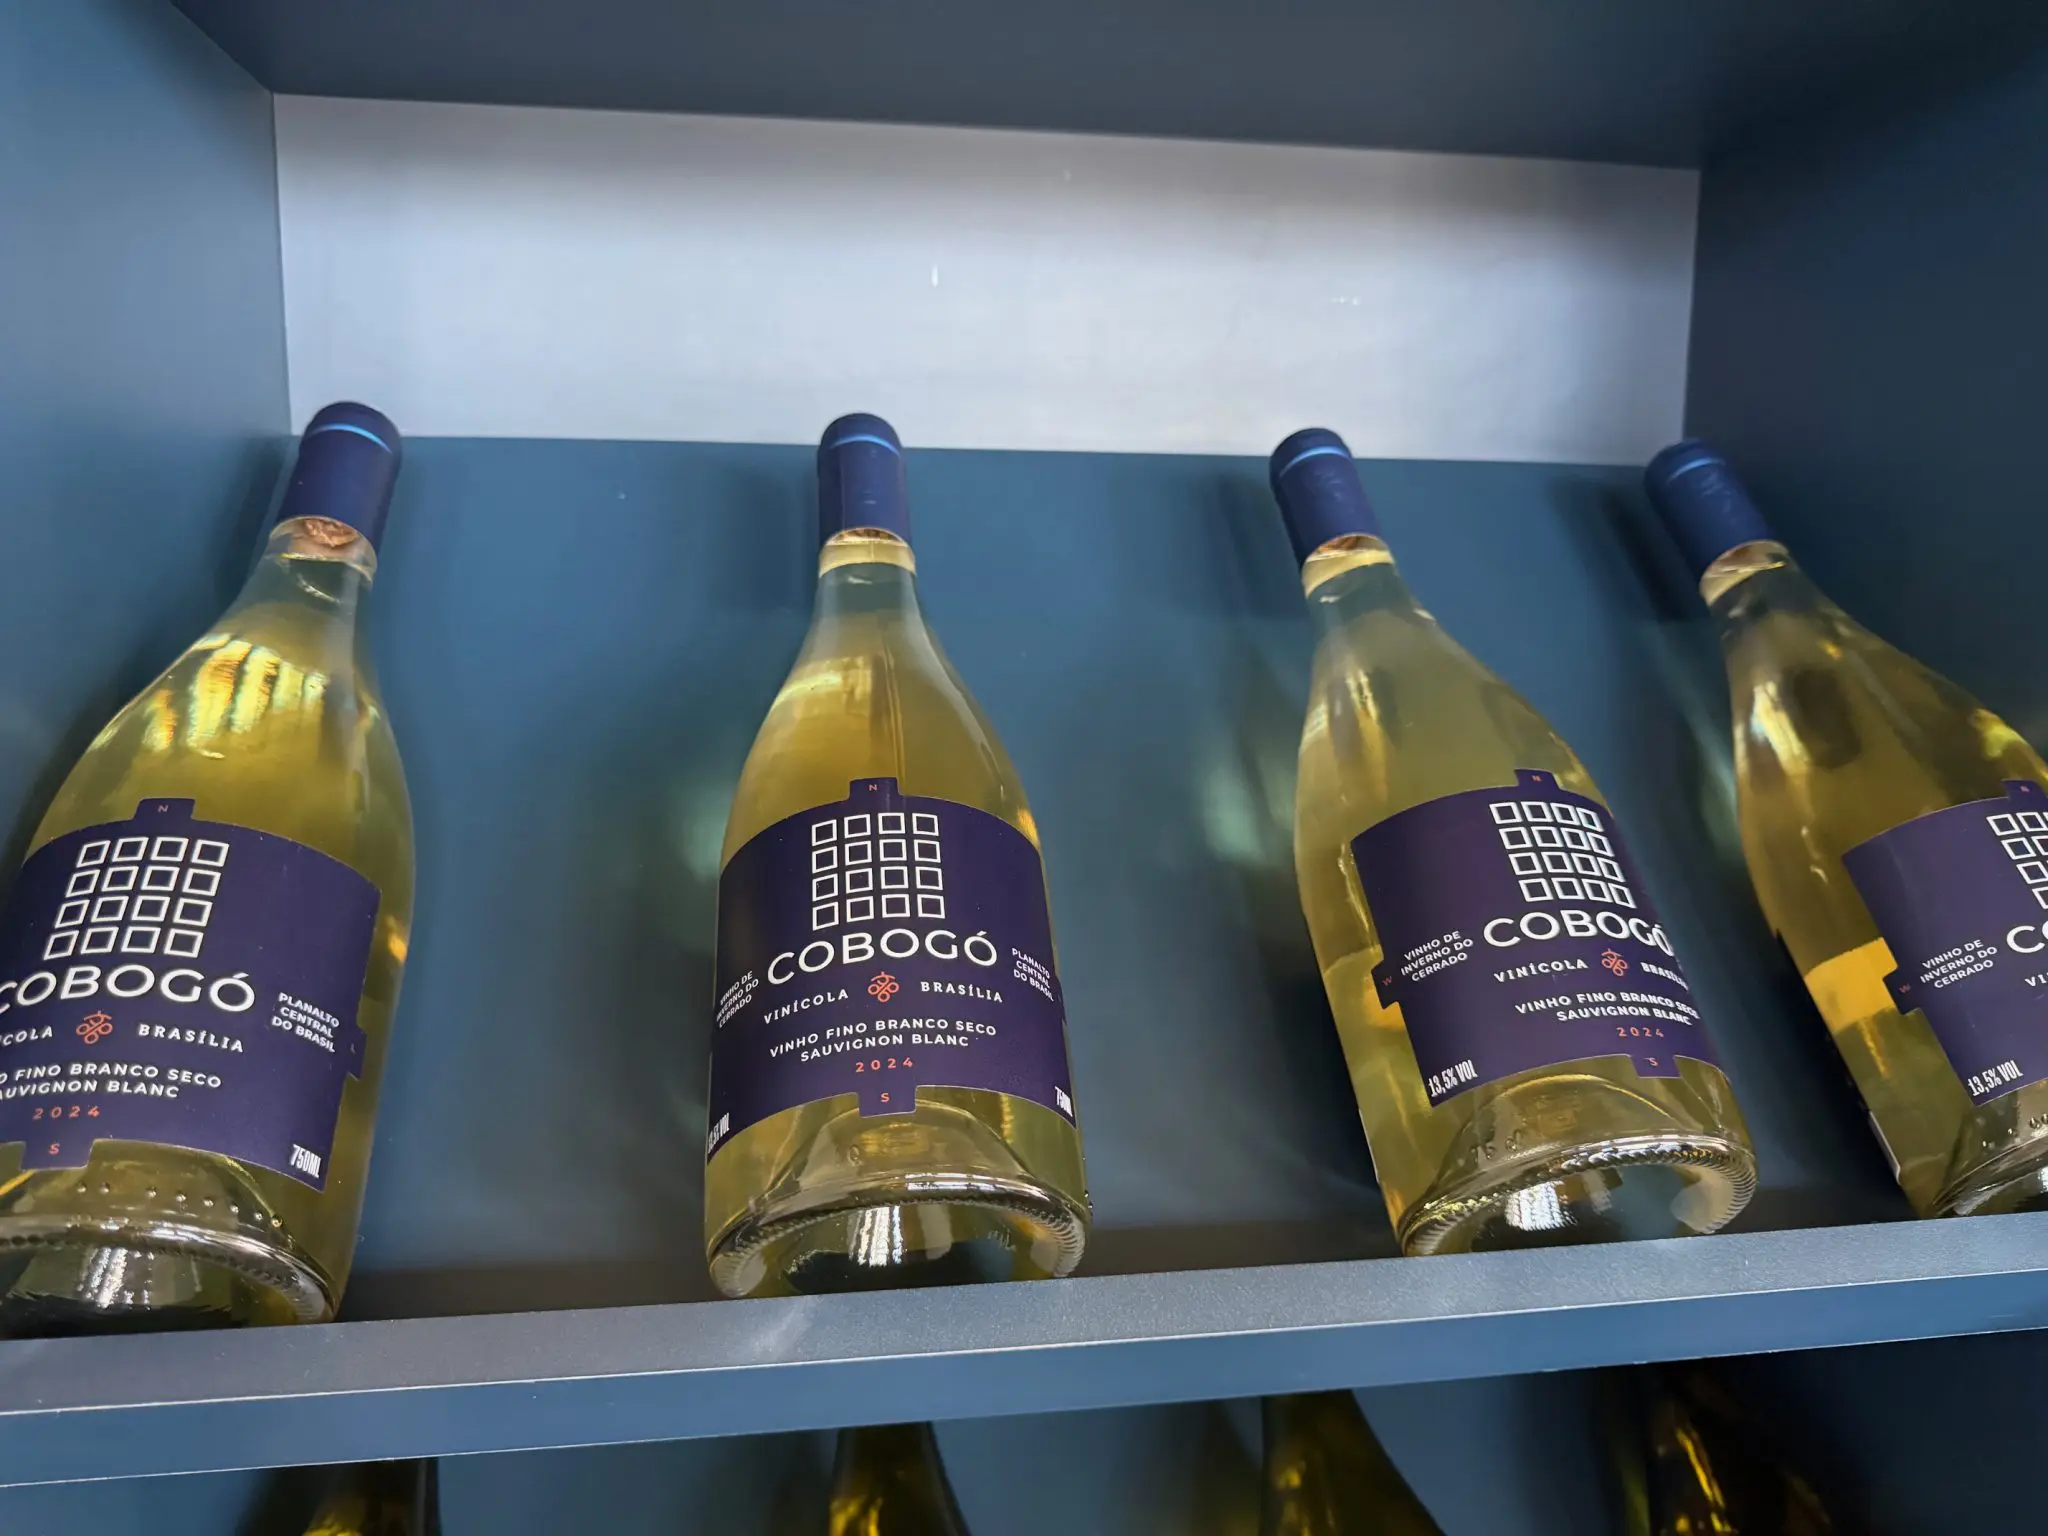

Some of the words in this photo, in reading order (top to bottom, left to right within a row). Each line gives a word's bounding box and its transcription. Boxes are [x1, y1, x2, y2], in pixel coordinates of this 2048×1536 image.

[868, 783, 878, 792] N
[157, 804, 170, 813] N
[767, 928, 998, 985] COBOGÓ
[1400, 946, 1451, 976] INVERNO
[1452, 937, 1474, 954] DO
[1403, 938, 1440, 961] VINHO
[1442, 930, 1461, 944] DE
[1923, 947, 1963, 969] VINHO
[1964, 939, 1984, 955] DE
[741, 970, 753, 985] DE
[1011, 947, 1051, 980] PLANALTO
[1013, 968, 1028, 982] DO
[1016, 960, 1050, 989] CENTRAL
[1411, 952, 1469, 983] CERRADO
[1494, 958, 1589, 984] VINÍCOLA
[1919, 957, 1974, 983] INVERNO
[1976, 946, 1998, 962] DO
[1933, 959, 1994, 989] CERRADO
[745, 978, 759, 993] DO
[278, 992, 340, 1029] PLANALTO
[763, 988, 849, 1025] VINÍCOLA
[920, 980, 1003, 1004] BRASÍLIA
[1515, 995, 1572, 1015] VINHO
[1577, 991, 1617, 1004] FINO
[1620, 991, 1675, 1008] BRANCO
[1556, 1006, 1652, 1022] SAUVIGNON
[1652, 1007, 1693, 1026] BLANC
[272, 1015, 294, 1031] DO
[296, 1023, 336, 1054] BRASIL
[280, 1006, 333, 1039] CENTRAL
[1616, 1026, 1664, 1038] 2024
[137, 1023, 244, 1054] BRASÍLIA
[770, 1033, 819, 1058] VINHO
[826, 1022, 867, 1040] FINO
[875, 1018, 949, 1031] BRANCO
[955, 1019, 997, 1036] SECO
[800, 1034, 904, 1063] SAUVIGNON
[911, 1033, 969, 1047] BLANC
[15, 1064, 61, 1082] FINO
[70, 1062, 159, 1079] BRANCO
[167, 1069, 222, 1089] SECO
[855, 1057, 914, 1074] 2024
[1429, 1070, 1457, 1098] 13,5%
[1455, 1059, 1478, 1081] VOL
[1967, 1067, 2003, 1098] 13,5%
[1997, 1059, 2025, 1083] VOL
[107, 1080, 180, 1098] BLANC
[880, 1091, 890, 1104] S
[33, 1105, 100, 1121] 2024
[47, 1142, 61, 1156] S
[289, 1143, 322, 1179] 750ML
